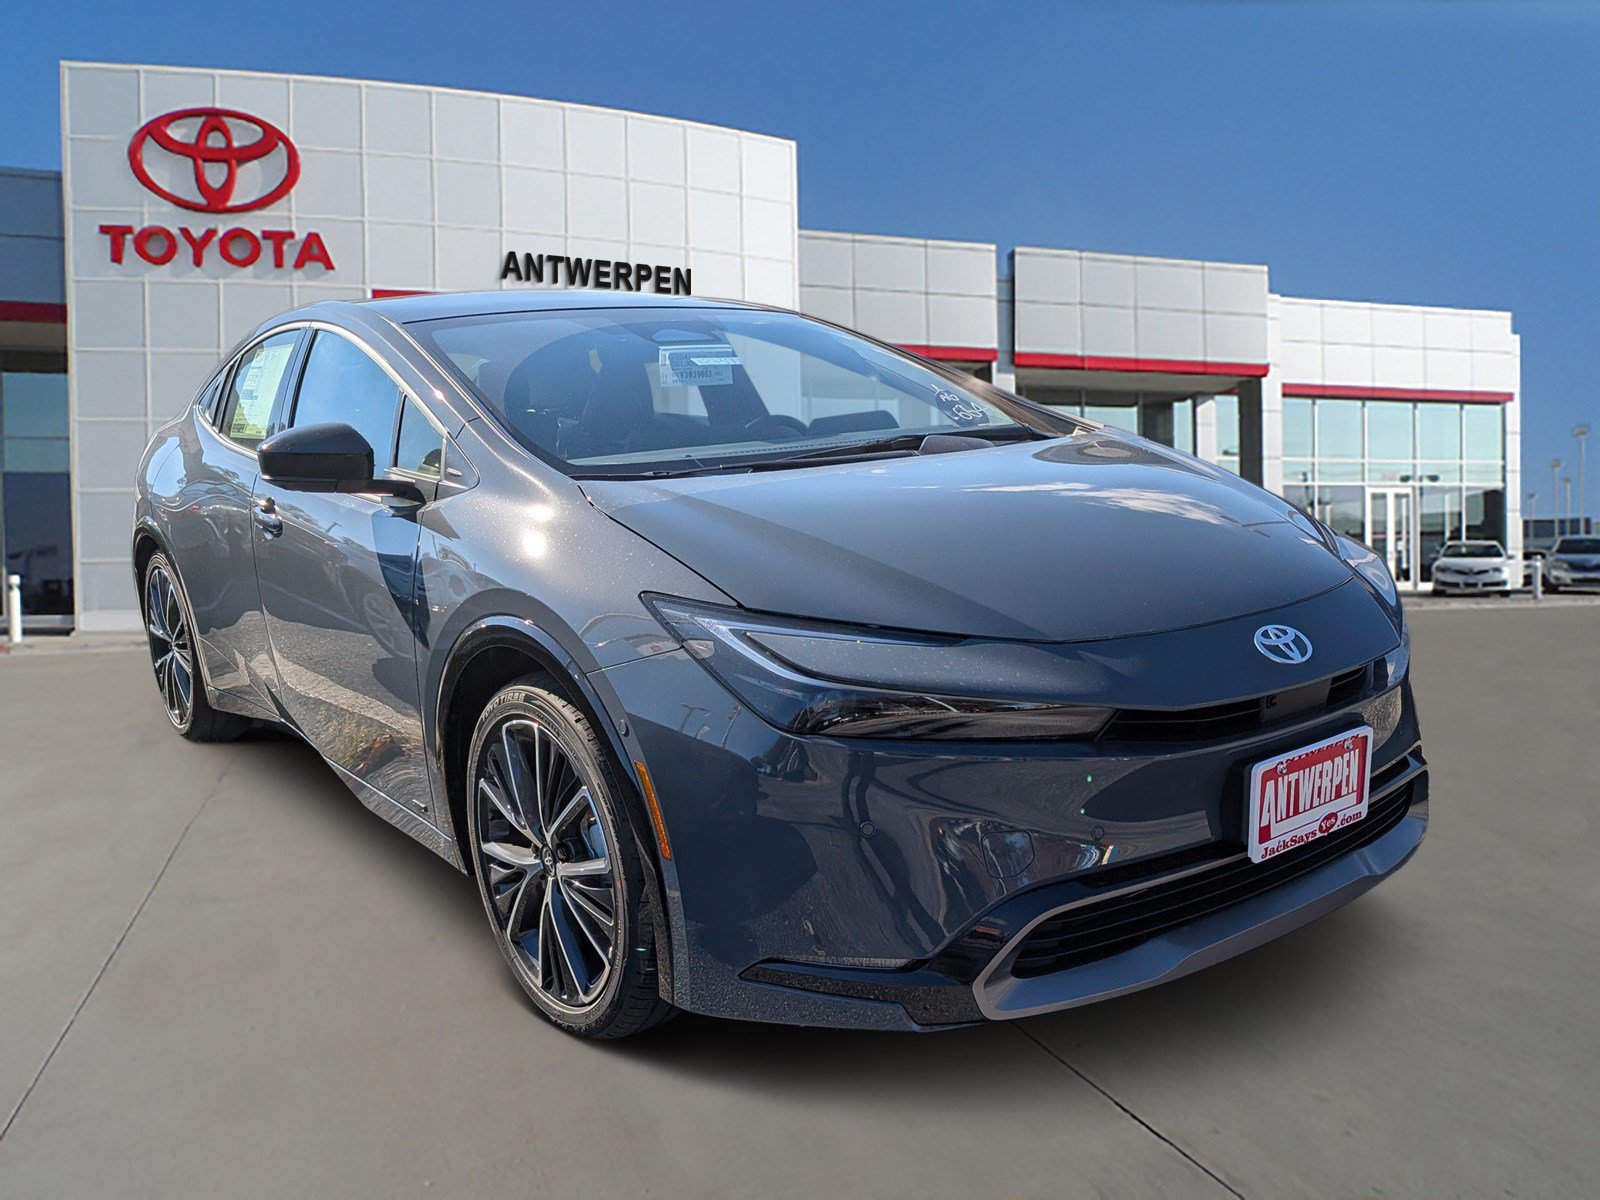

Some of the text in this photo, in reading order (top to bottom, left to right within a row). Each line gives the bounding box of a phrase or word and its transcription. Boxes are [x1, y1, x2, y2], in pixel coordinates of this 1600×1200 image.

[99, 224, 336, 271] TOYOTA
[500, 250, 692, 296] ANTWERPEN
[1260, 749, 1359, 838] ANTWERPEN
